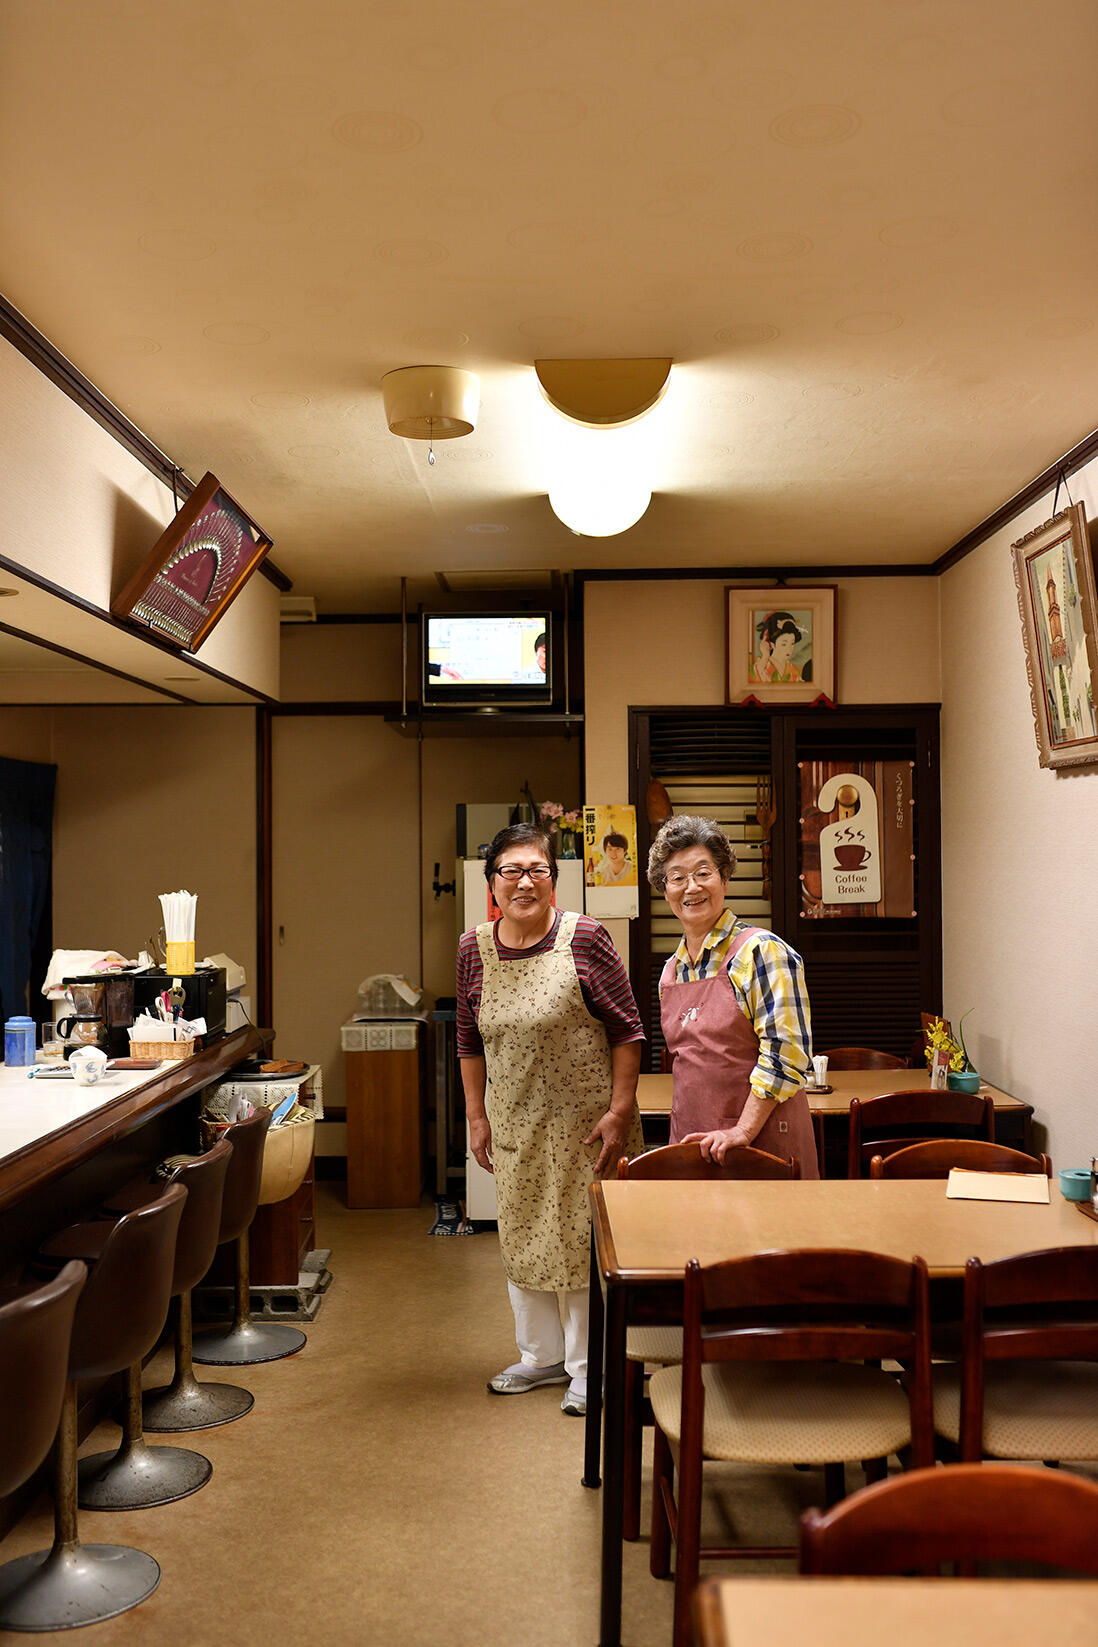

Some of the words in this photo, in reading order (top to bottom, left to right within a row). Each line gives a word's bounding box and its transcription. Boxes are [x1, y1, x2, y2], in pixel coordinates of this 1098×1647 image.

[585, 808, 596, 846] 一番搾り
[835, 874, 867, 884] Coffee
[838, 885, 866, 894] Break
